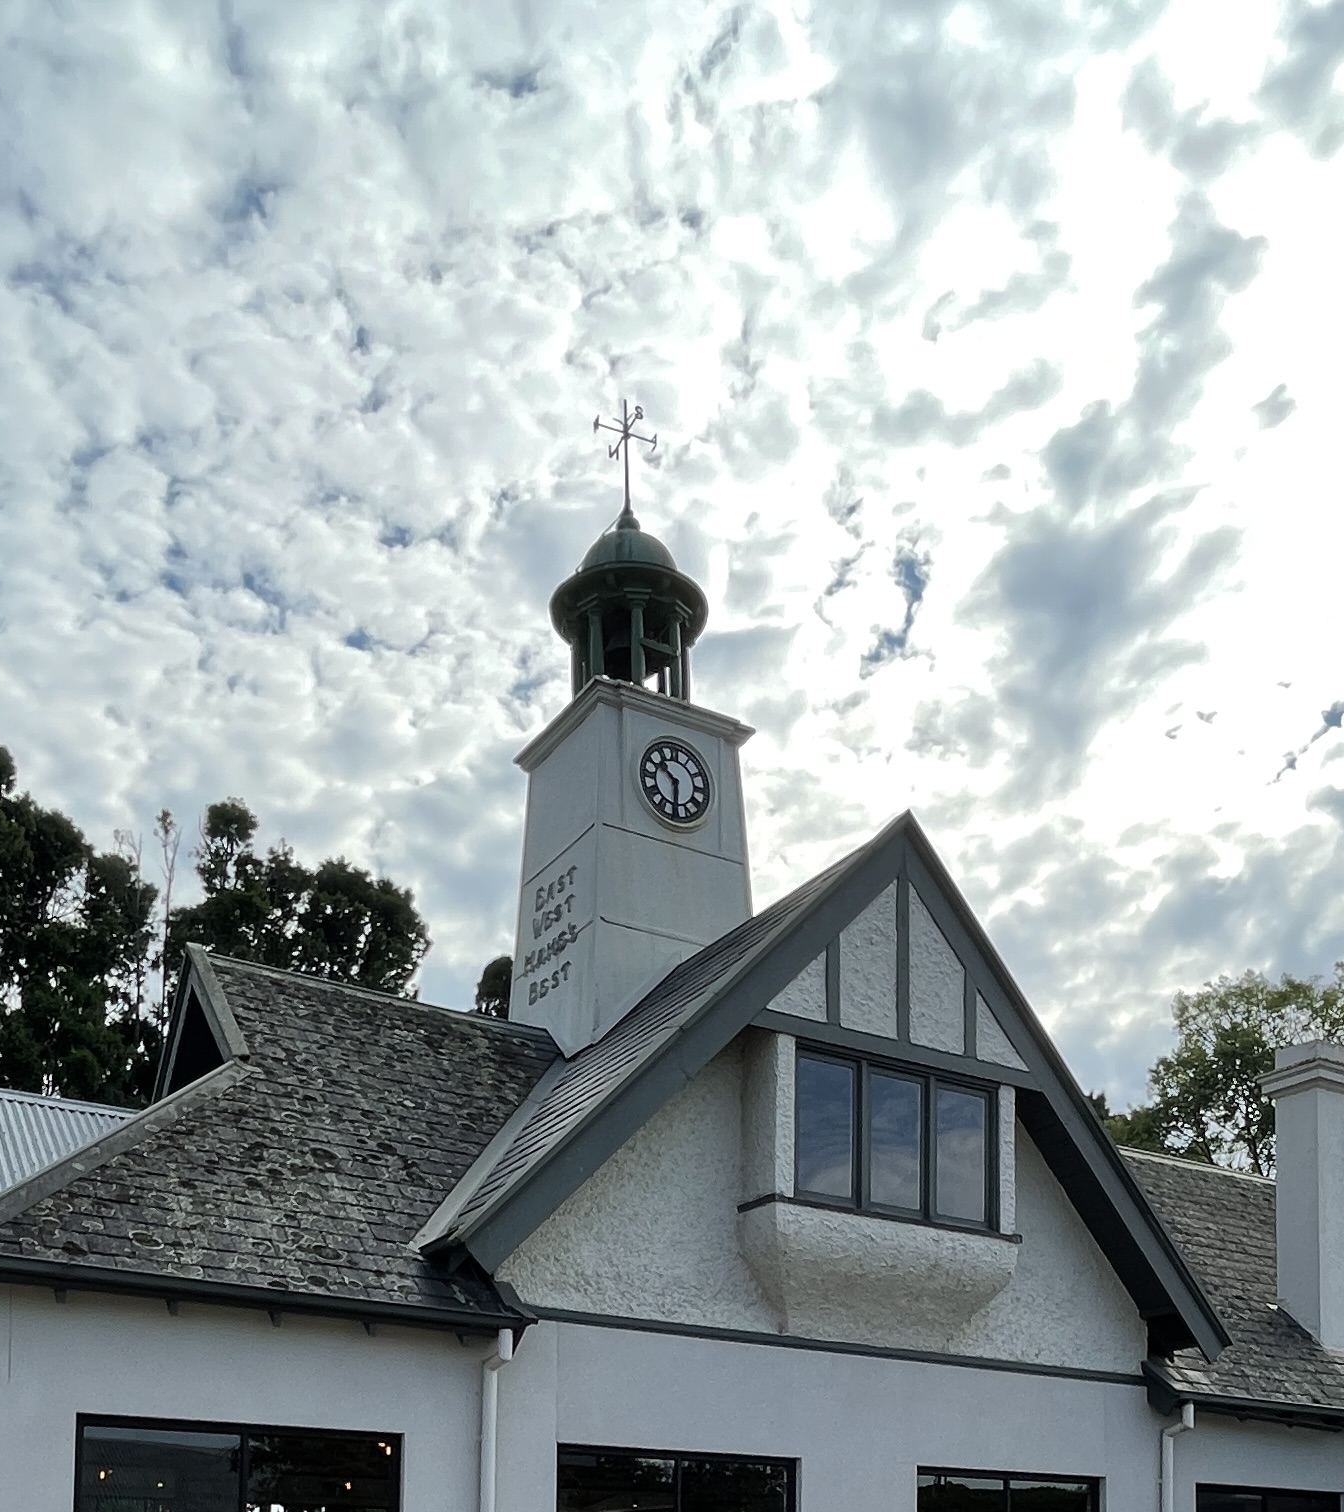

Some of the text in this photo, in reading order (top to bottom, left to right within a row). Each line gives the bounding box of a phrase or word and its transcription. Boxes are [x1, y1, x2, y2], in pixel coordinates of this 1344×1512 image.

[535, 865, 577, 912] EAST
[533, 894, 576, 939] WEST
[528, 961, 572, 1005] BEST
